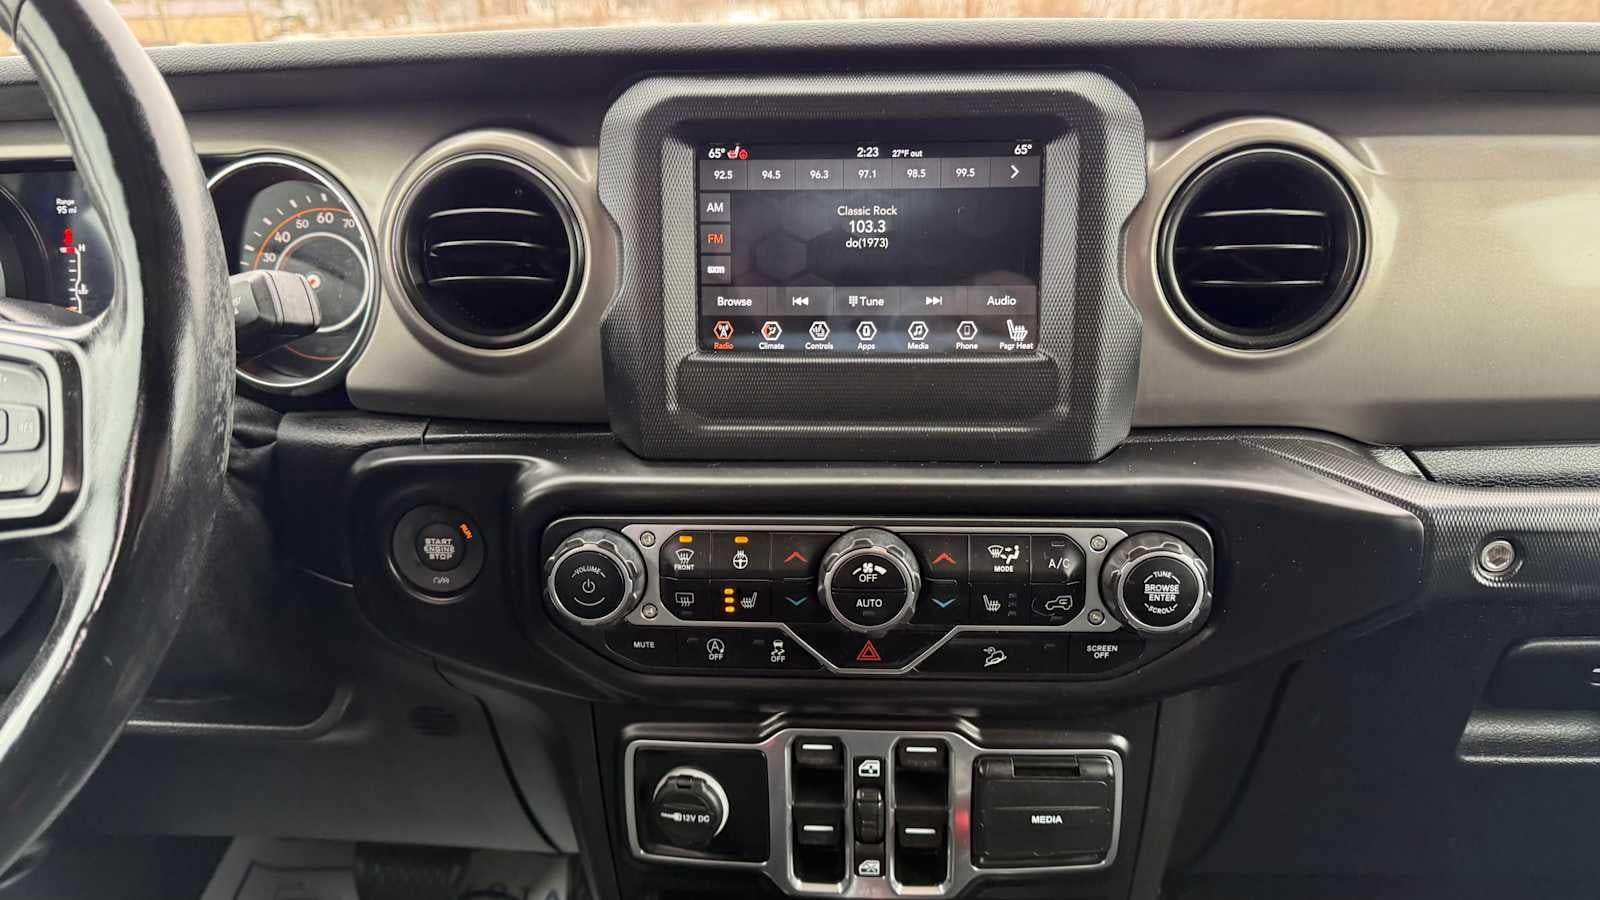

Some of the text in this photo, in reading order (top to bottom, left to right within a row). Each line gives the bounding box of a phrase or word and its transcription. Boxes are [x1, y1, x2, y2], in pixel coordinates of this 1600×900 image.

[857, 147, 879, 158] 2:23
[910, 150, 923, 158] out
[714, 170, 733, 180] 92.5
[762, 170, 781, 180] 94.5
[809, 169, 829, 179] 96.3
[858, 169, 877, 179] 97.1
[906, 168, 926, 178] 98.5
[955, 168, 975, 177] 99.5
[56, 198, 75, 207] Range
[706, 202, 724, 213] AM
[56, 206, 77, 214] 95 mi
[837, 204, 898, 216] Classic Rock
[316, 212, 334, 224] 60
[342, 217, 355, 229] 70
[296, 218, 310, 229] 50
[848, 219, 886, 233] 103.3
[274, 231, 291, 244] 40
[707, 233, 724, 245] FM
[845, 236, 889, 249] do(1973)
[263, 252, 277, 263] 30
[717, 296, 752, 307] Browse
[860, 296, 885, 306] Tune
[987, 296, 1017, 306] Audio
[714, 342, 734, 350] Radio
[758, 342, 784, 350] Climate
[805, 342, 834, 350] Controls
[857, 342, 876, 352] Apps
[907, 342, 929, 350] Media
[956, 342, 978, 350] Phone
[1015, 342, 1034, 350] Heat
[458, 523, 473, 540] RUN
[423, 545, 455, 553] ENGINE
[993, 565, 1014, 573] MODE
[1048, 559, 1070, 569] A/C
[574, 565, 602, 575] VOLUME
[1152, 570, 1173, 579] TUNE
[858, 573, 878, 583] OFF
[1144, 584, 1180, 592] BROWSE
[855, 598, 883, 608] AUTO
[1148, 594, 1176, 602] ENTER
[1148, 604, 1175, 615] SCROLL
[633, 641, 655, 649] MUTE
[708, 653, 724, 661] OFF
[770, 655, 786, 663] OFF
[682, 814, 710, 824] 12V DC
[1031, 815, 1063, 824] MEDIA
